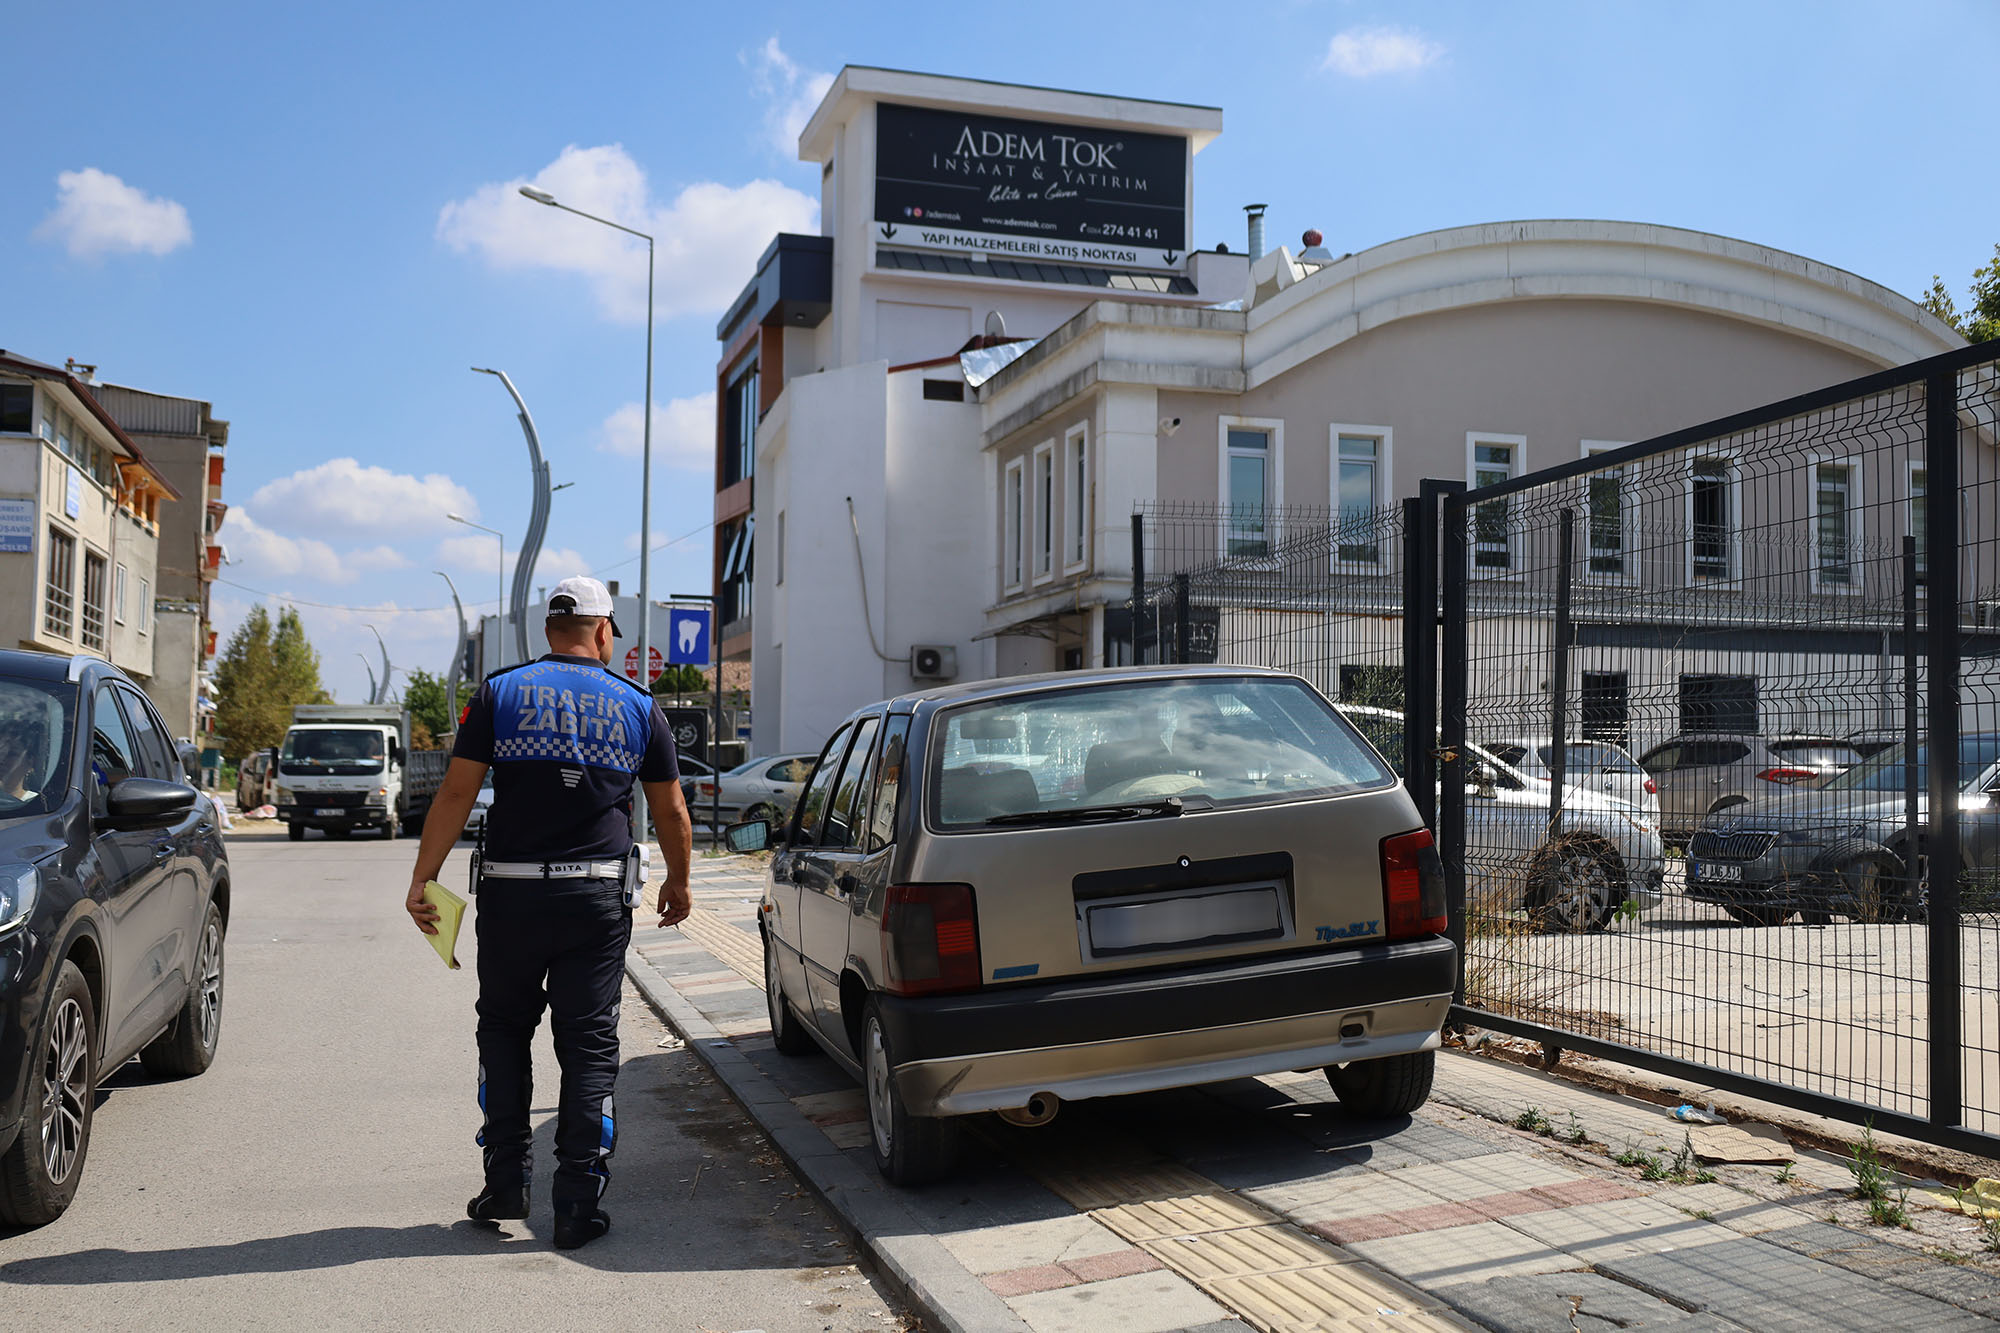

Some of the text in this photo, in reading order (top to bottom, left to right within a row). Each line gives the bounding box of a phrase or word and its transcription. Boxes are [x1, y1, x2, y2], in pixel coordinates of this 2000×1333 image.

[953, 125, 1047, 163] ADEM
[1032, 166, 1045, 181] &
[1064, 169, 1149, 191] YATIRIM
[1027, 192, 1038, 200] ve
[982, 216, 1058, 231] www.ademtok.com
[1102, 223, 1125, 237] 274
[1127, 226, 1141, 238] 41
[1144, 228, 1159, 240] 41
[921, 232, 1137, 263] YAPI MALZEMELERİ SATIŞ NOKTASI
[522, 662, 627, 695] BÜYÜKŞEHİR
[518, 685, 626, 722] TRAFİK
[518, 708, 627, 746] ZABITA
